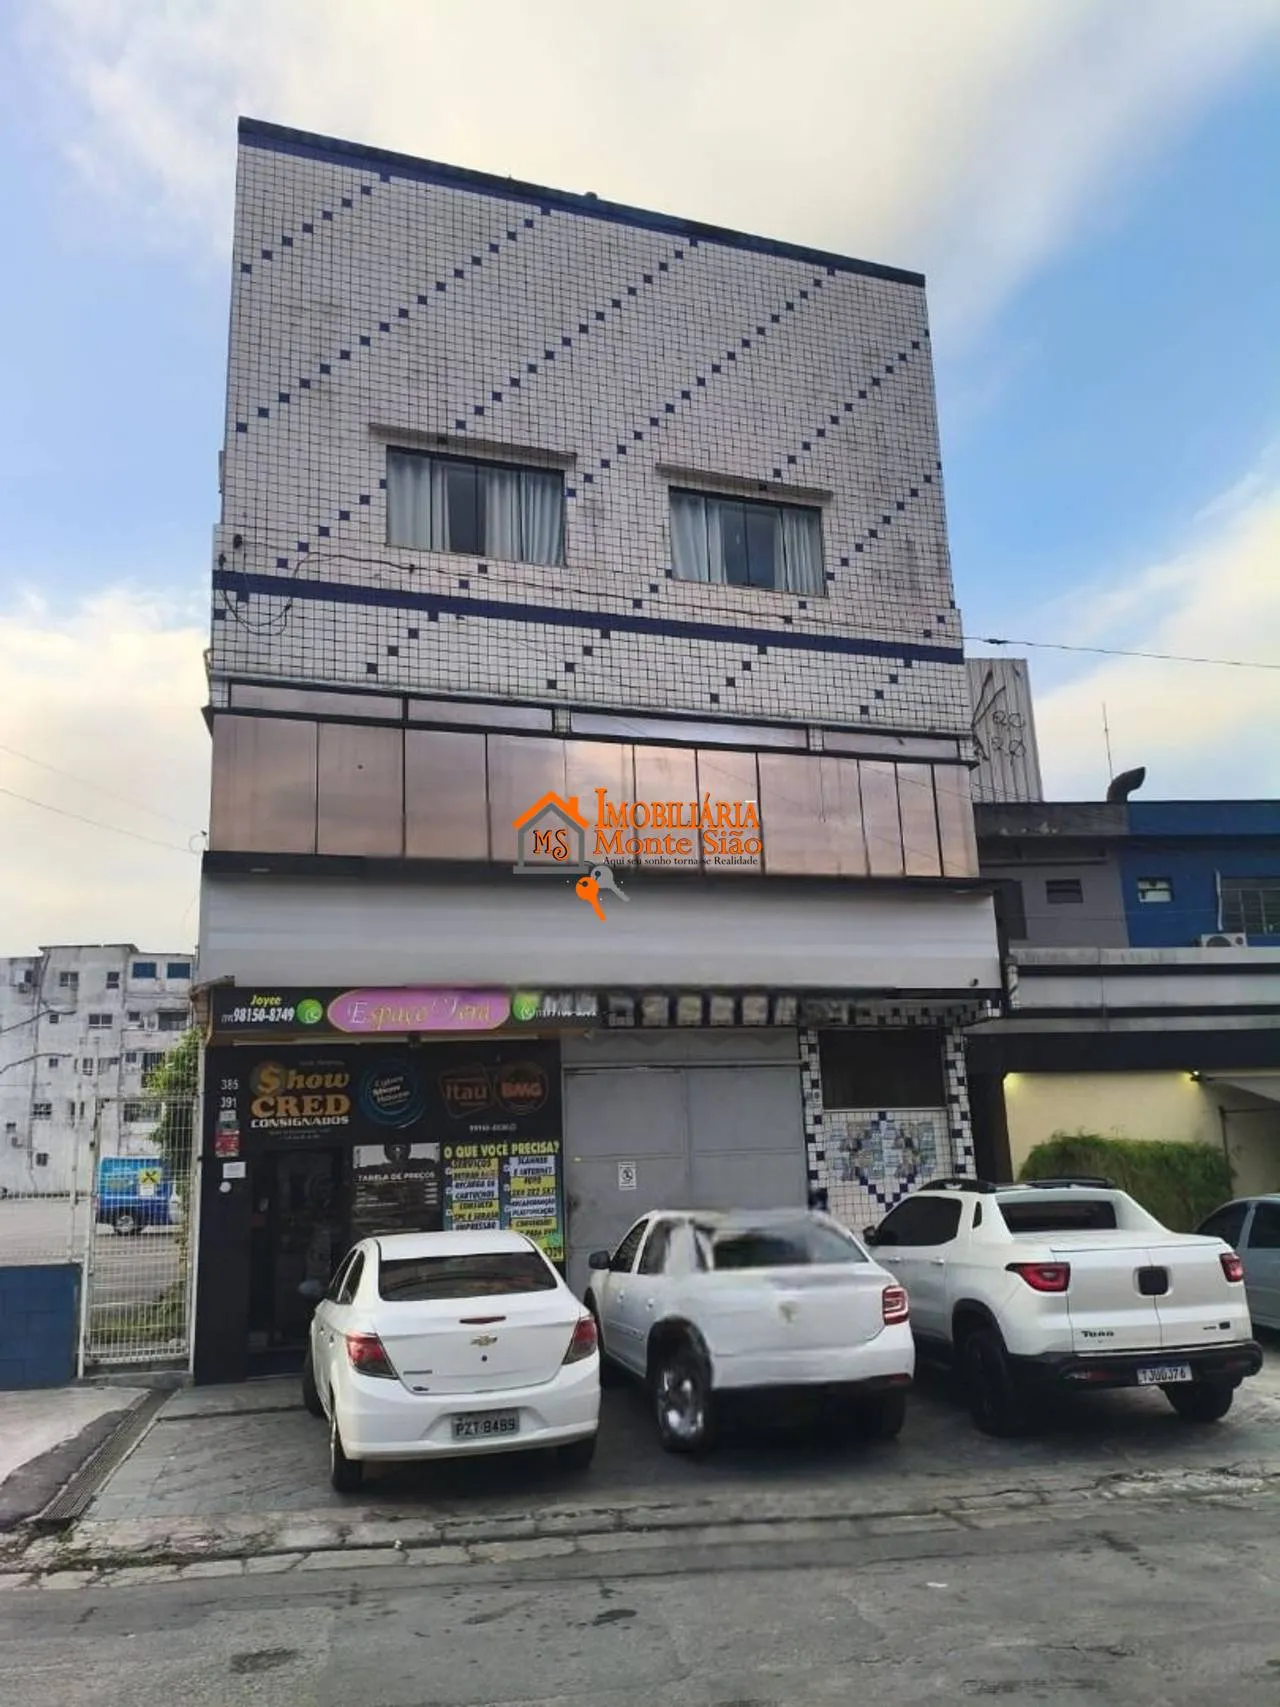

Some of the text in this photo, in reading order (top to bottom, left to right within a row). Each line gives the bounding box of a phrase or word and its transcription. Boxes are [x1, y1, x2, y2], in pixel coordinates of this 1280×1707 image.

[250, 995, 282, 1007] Joyce
[502, 1082, 542, 1098] BMG
[251, 1094, 351, 1118] CRED
[250, 1116, 349, 1129] CONSIGNADOS
[444, 1146, 453, 1158] O
[455, 1145, 478, 1158] QUE
[511, 1141, 560, 1155] PRECISA?
